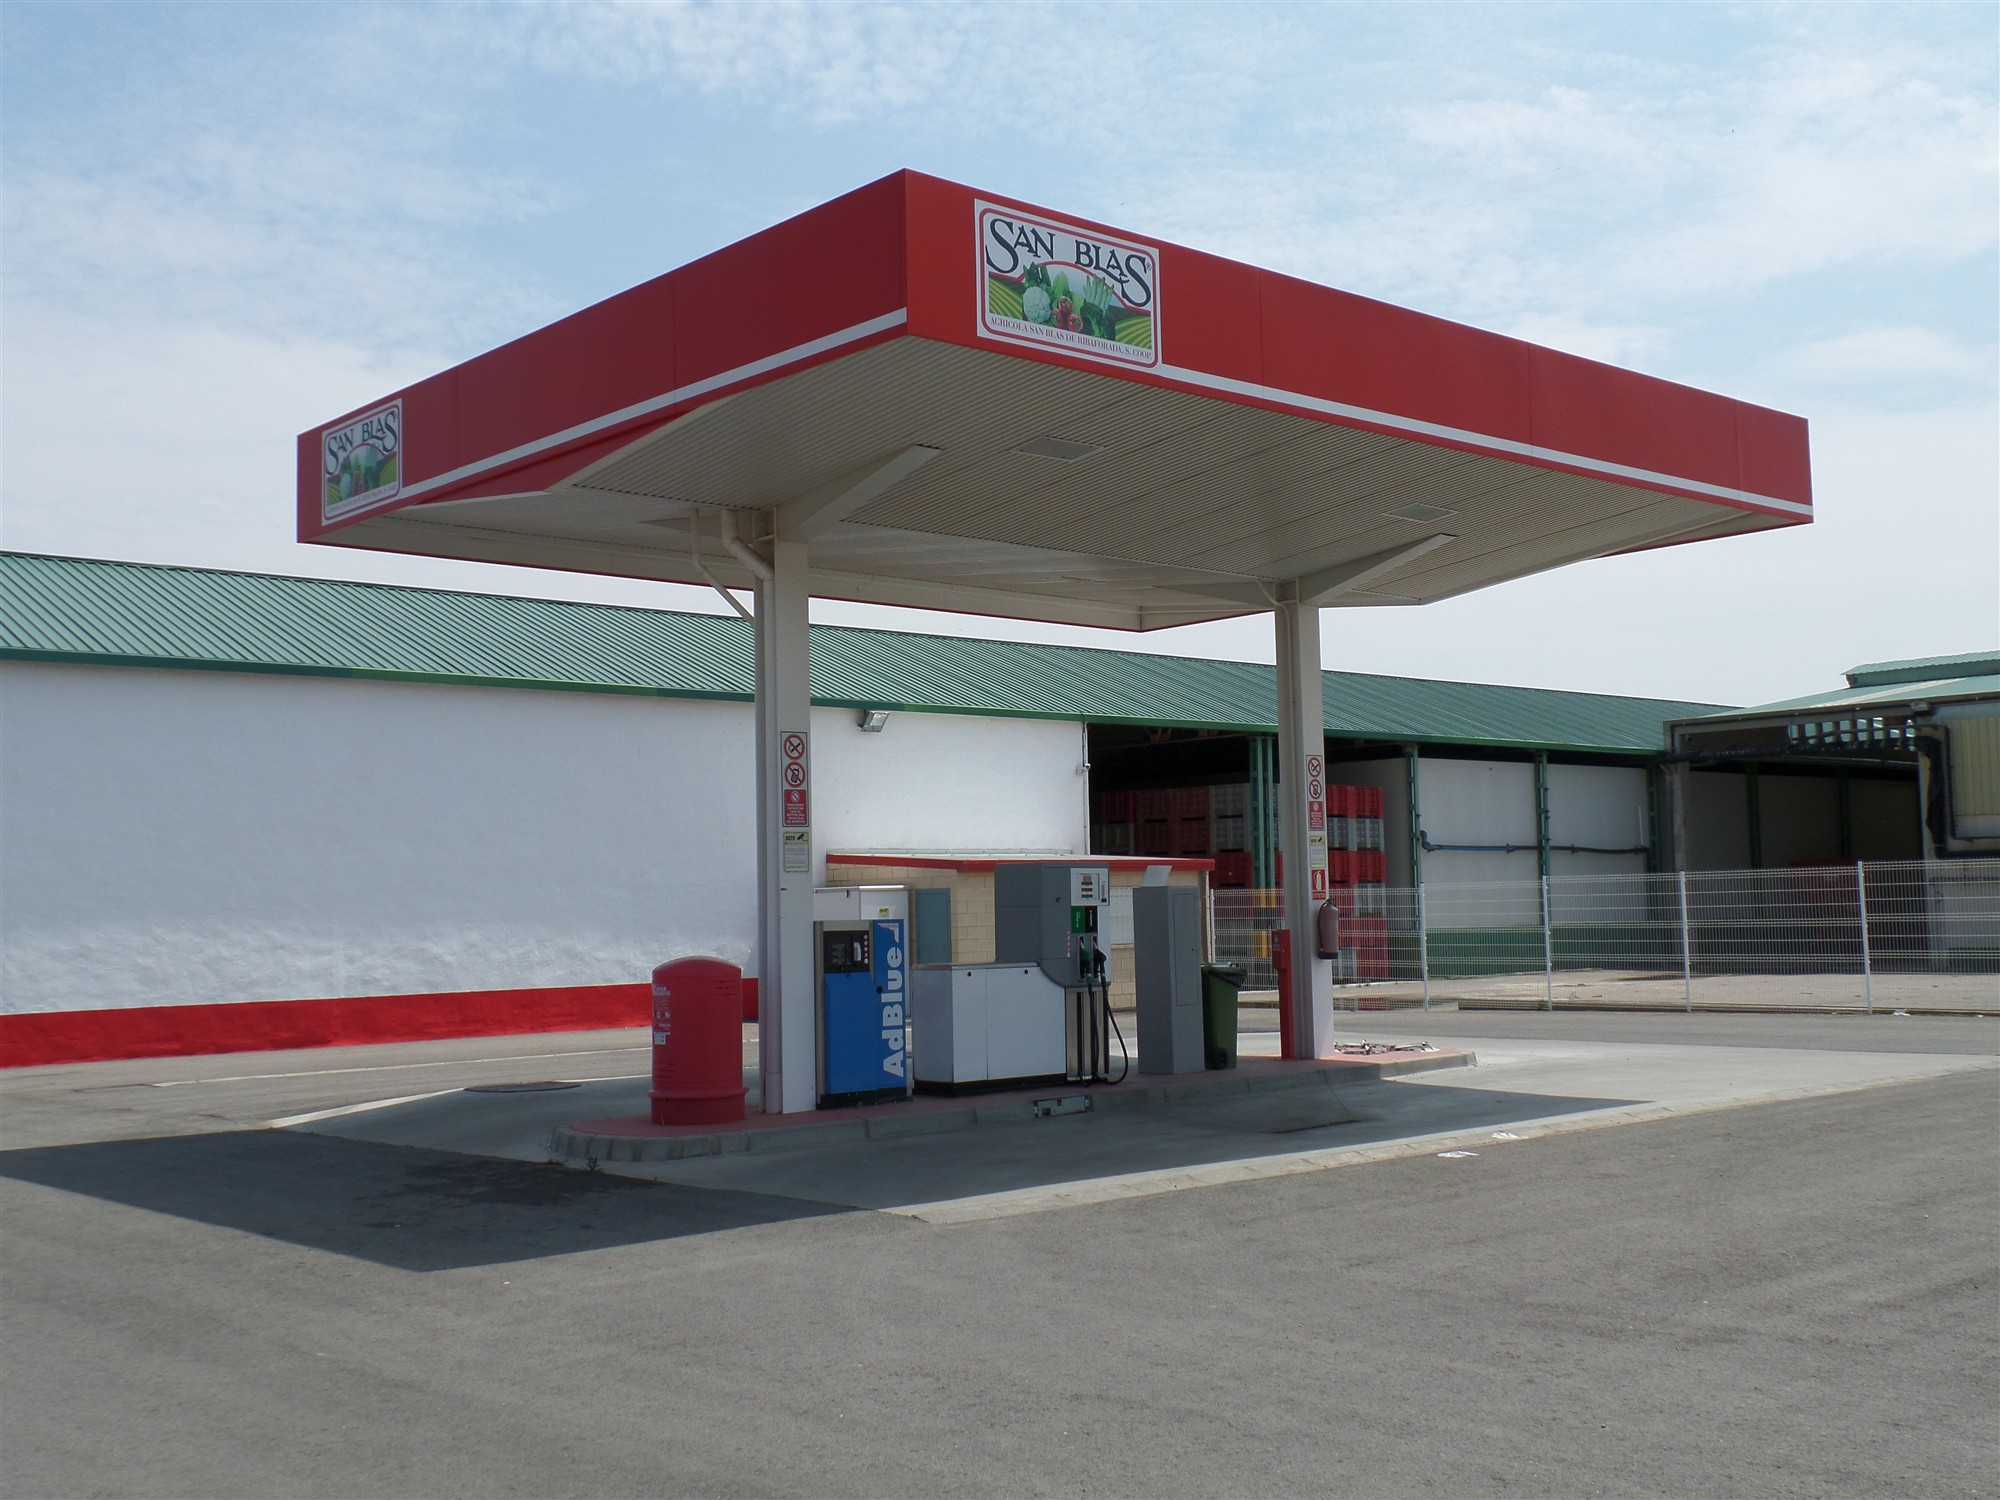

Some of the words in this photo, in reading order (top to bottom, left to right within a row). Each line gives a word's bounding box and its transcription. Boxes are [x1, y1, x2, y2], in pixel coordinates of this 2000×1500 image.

[985, 218, 1056, 274] SAN
[1074, 239, 1152, 307] BLAS
[990, 317, 1029, 333] AGRICOLA
[1029, 325, 1044, 337] SAN
[1045, 329, 1065, 341] BLAS
[1065, 333, 1077, 343] DE
[325, 429, 354, 476] SAN
[361, 410, 398, 453] BLAS
[881, 946, 904, 1078] AdBlue
